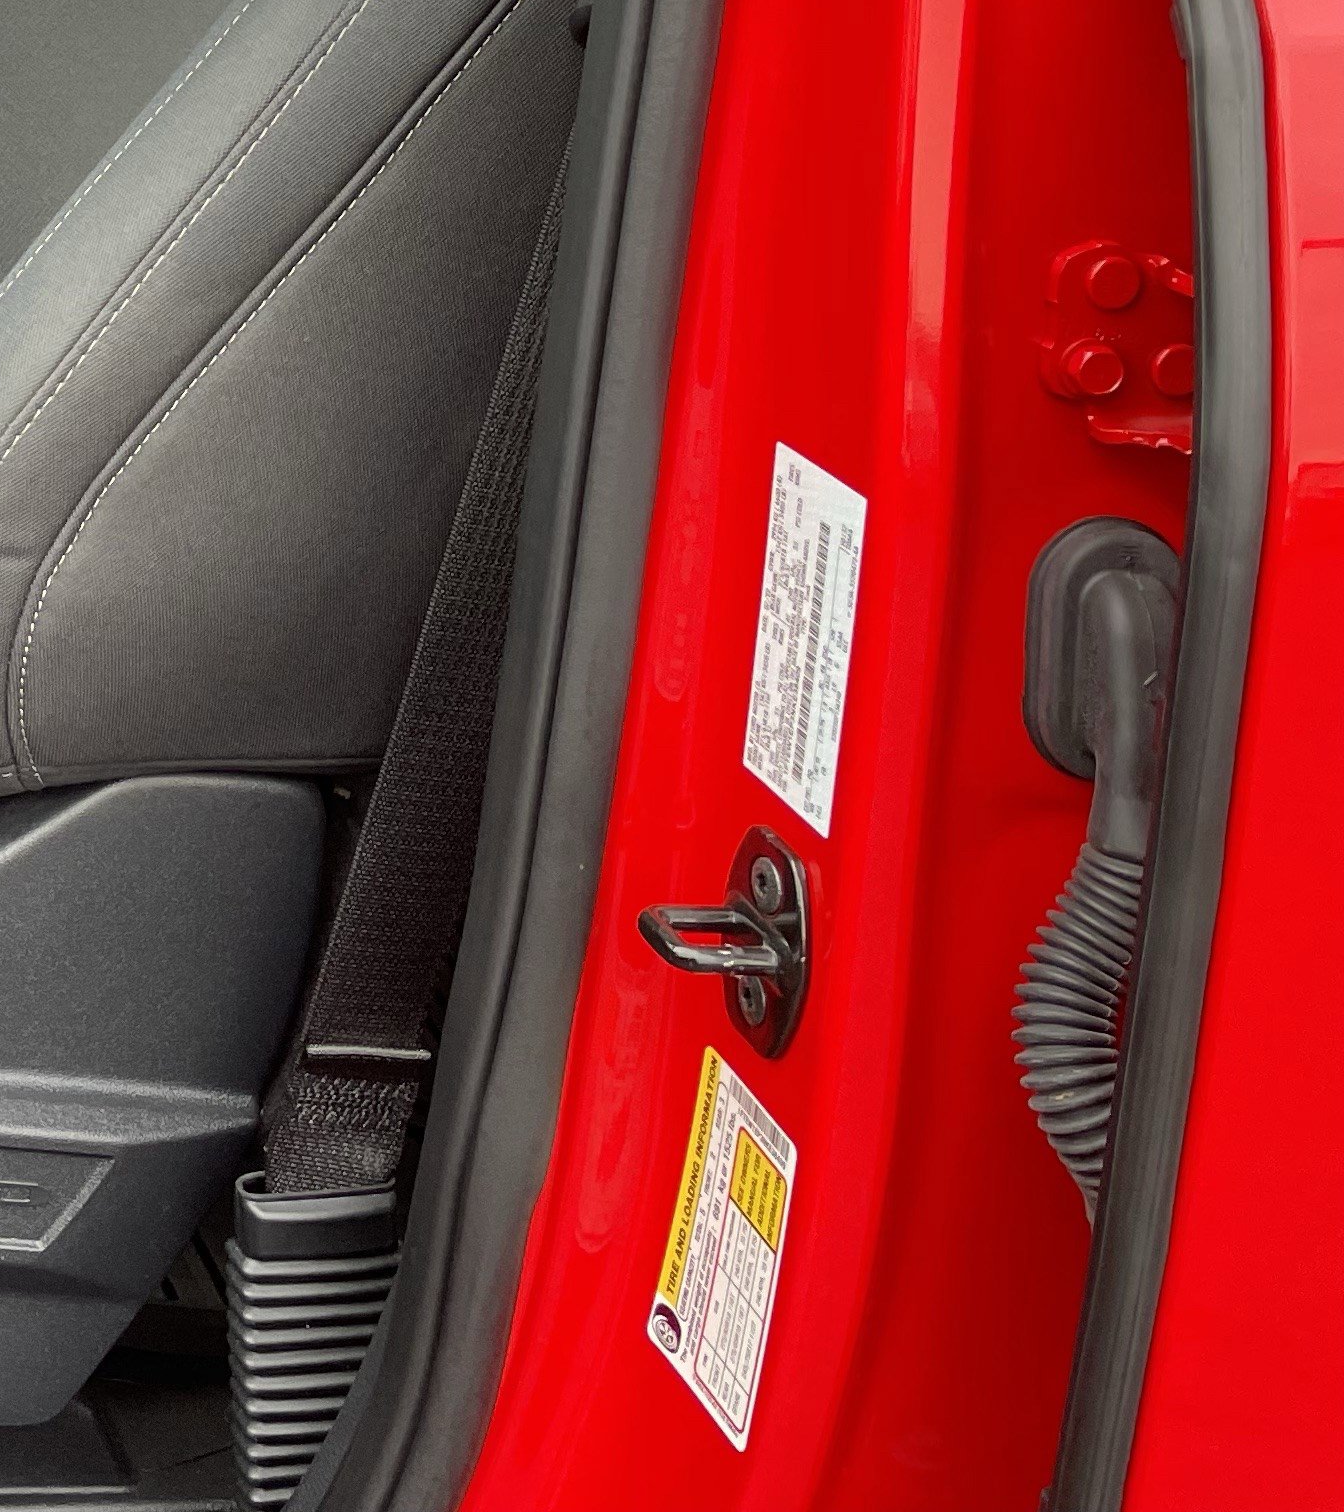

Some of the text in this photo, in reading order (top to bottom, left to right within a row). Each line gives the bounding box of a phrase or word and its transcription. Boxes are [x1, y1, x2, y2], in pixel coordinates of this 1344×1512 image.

[666, 1054, 717, 1297] TIRE AND LOADING INFORMATION
[746, 1173, 757, 1218] MANUAL
[753, 1151, 761, 1175] FOR
[756, 1167, 771, 1228] ADDITIONAL
[765, 1172, 782, 1244] INFORMATION
